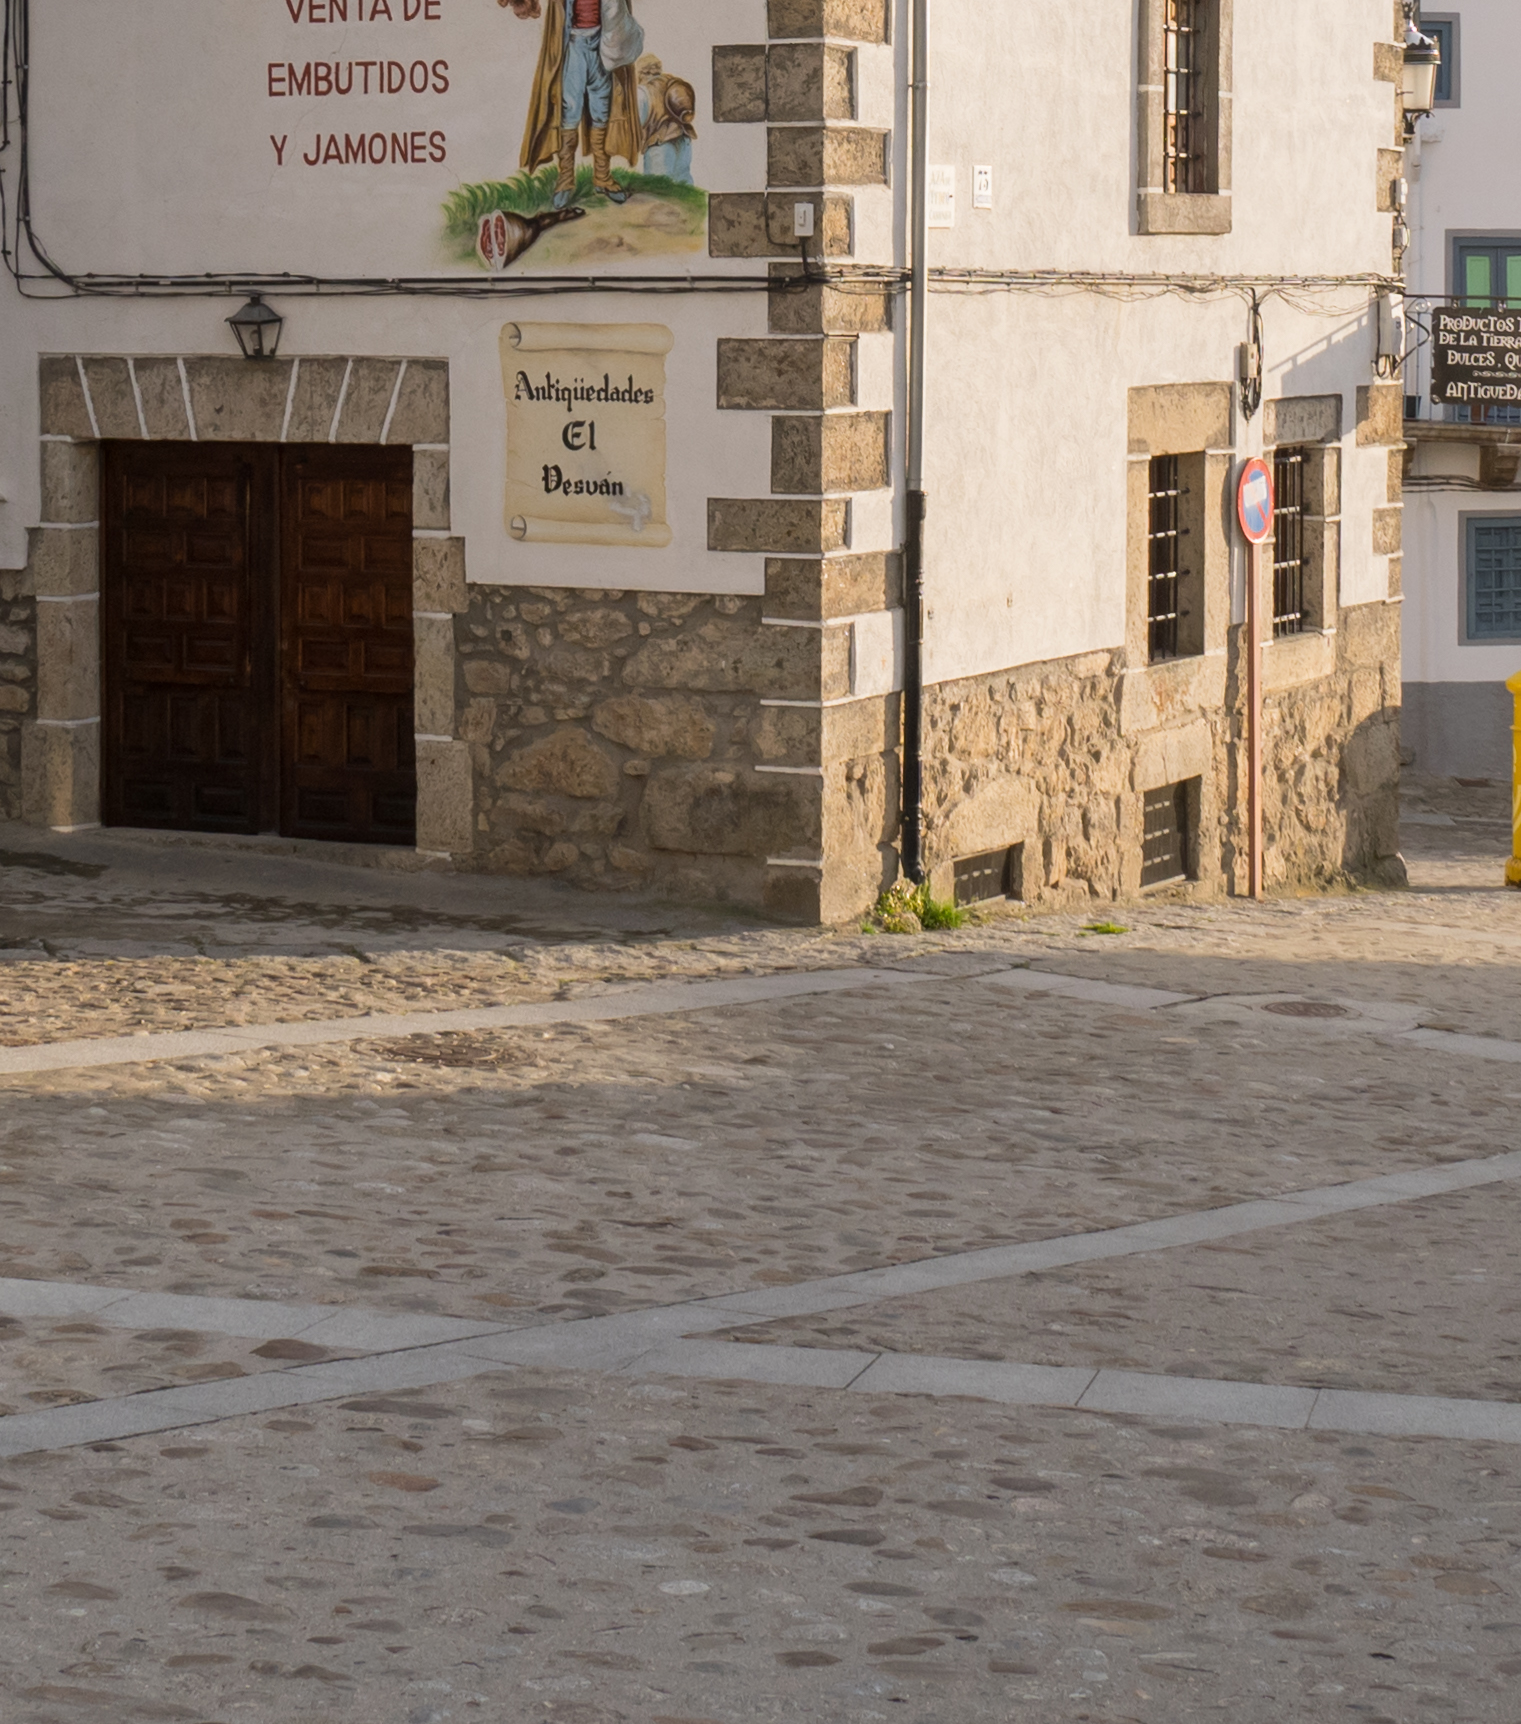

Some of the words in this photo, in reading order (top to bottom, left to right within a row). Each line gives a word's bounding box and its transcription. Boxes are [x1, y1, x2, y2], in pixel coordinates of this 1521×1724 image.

[268, 59, 450, 97] EMBUTIDOS
[269, 134, 288, 166] Y
[303, 130, 447, 166] JAMONES
[1438, 331, 1457, 345] DE
[1459, 332, 1478, 346] LA
[1439, 314, 1515, 333] PRODUCTOS
[562, 420, 597, 451] El
